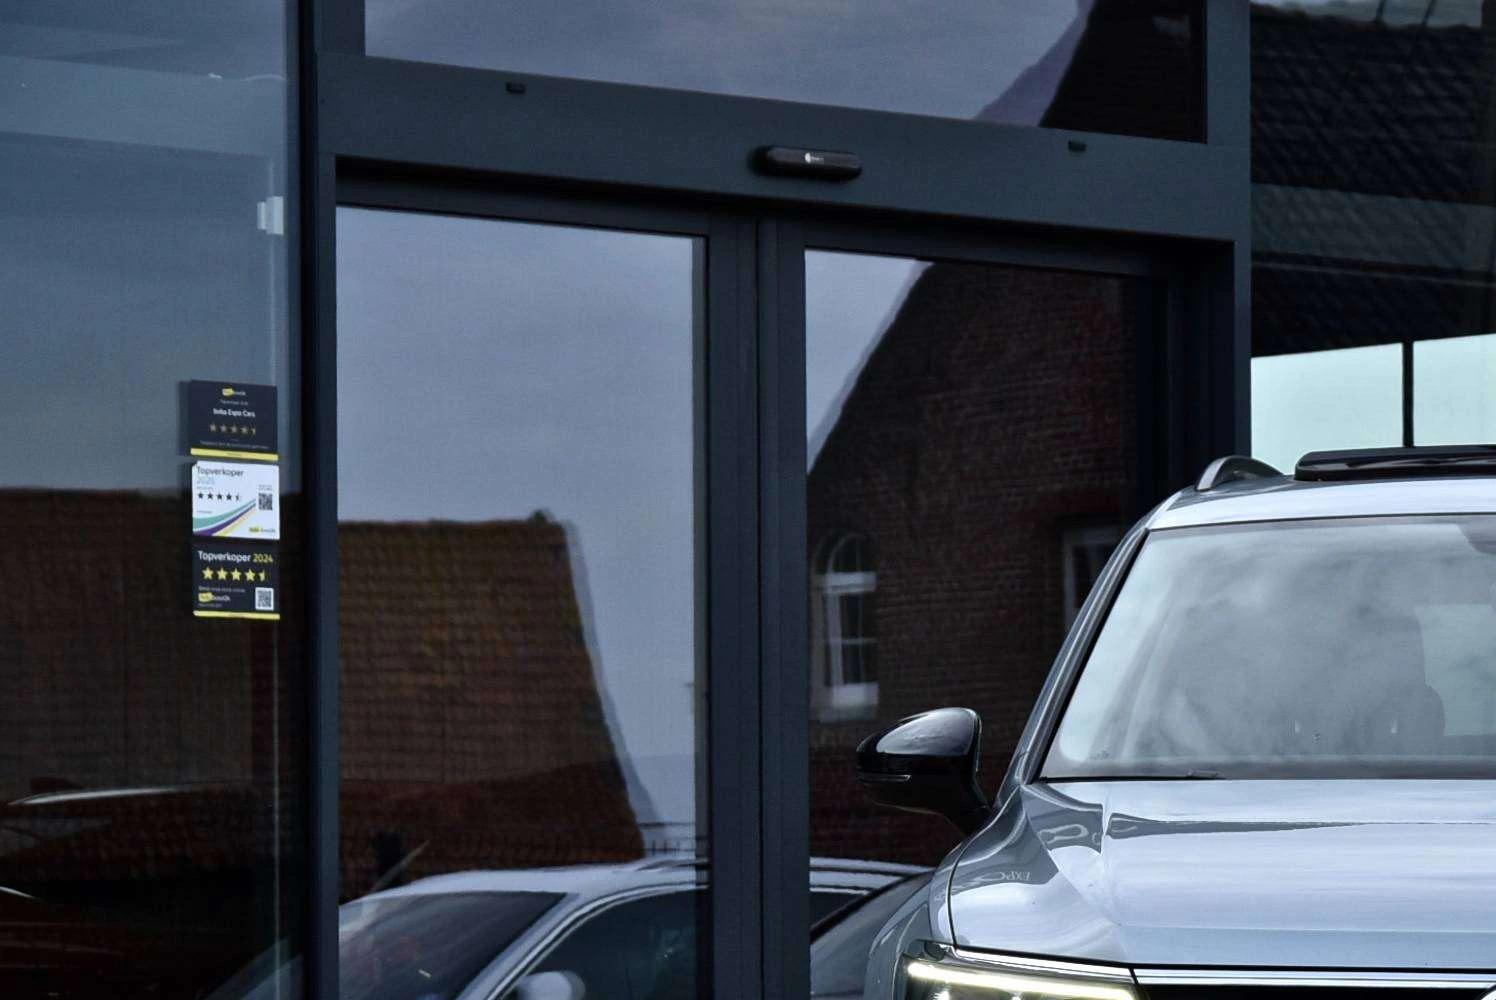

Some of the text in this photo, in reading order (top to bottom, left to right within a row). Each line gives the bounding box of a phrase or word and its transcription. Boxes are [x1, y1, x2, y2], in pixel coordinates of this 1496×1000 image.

[197, 466, 244, 477] Topverkoper
[197, 550, 274, 564] Topverkoper 2024
